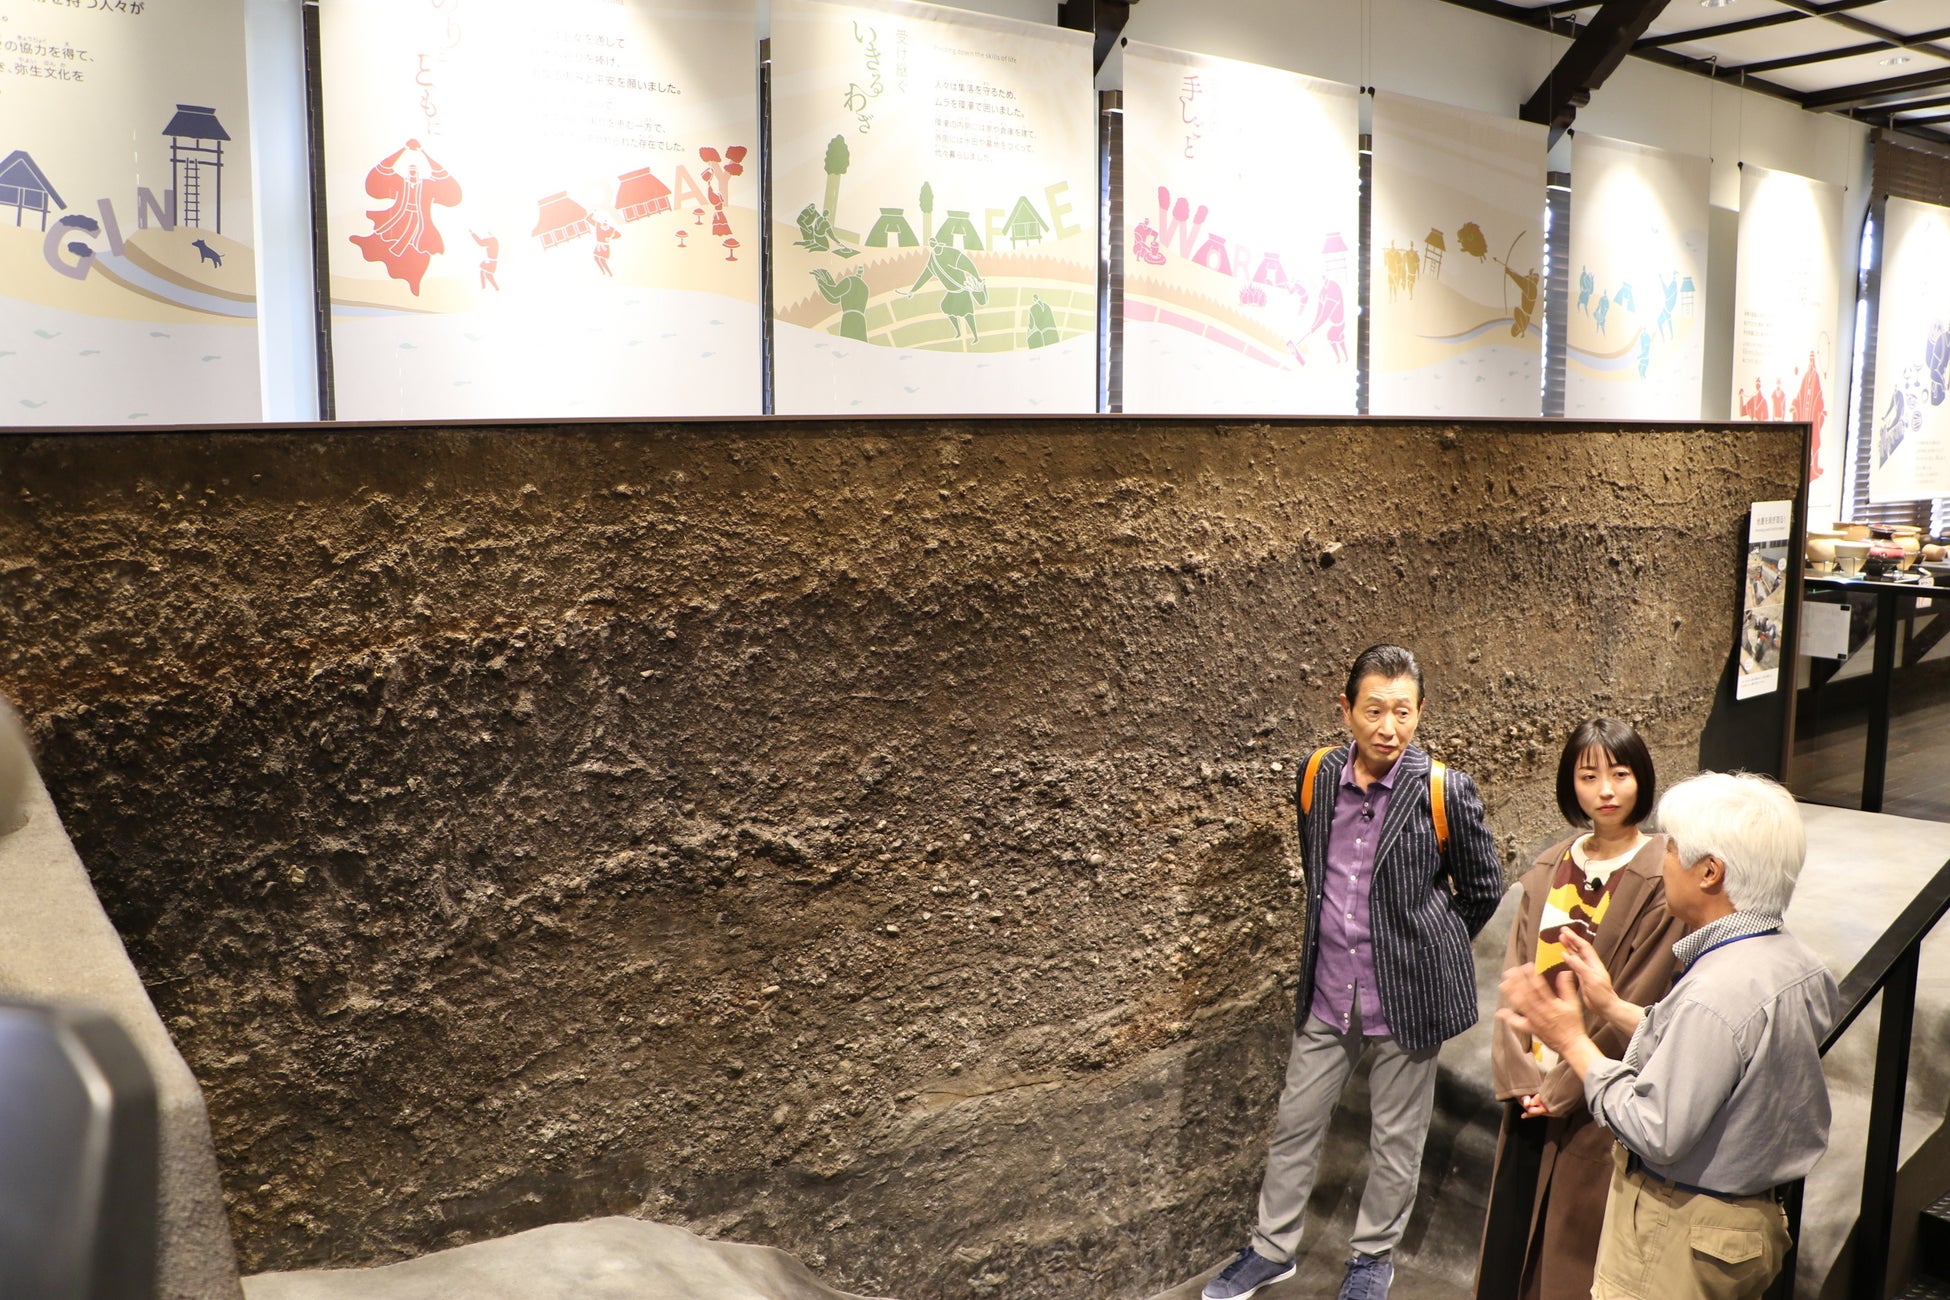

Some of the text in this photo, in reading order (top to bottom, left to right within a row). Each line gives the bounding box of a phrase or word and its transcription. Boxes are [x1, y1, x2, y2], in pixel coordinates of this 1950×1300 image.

[0, 40, 95, 63] の協力を得て、
